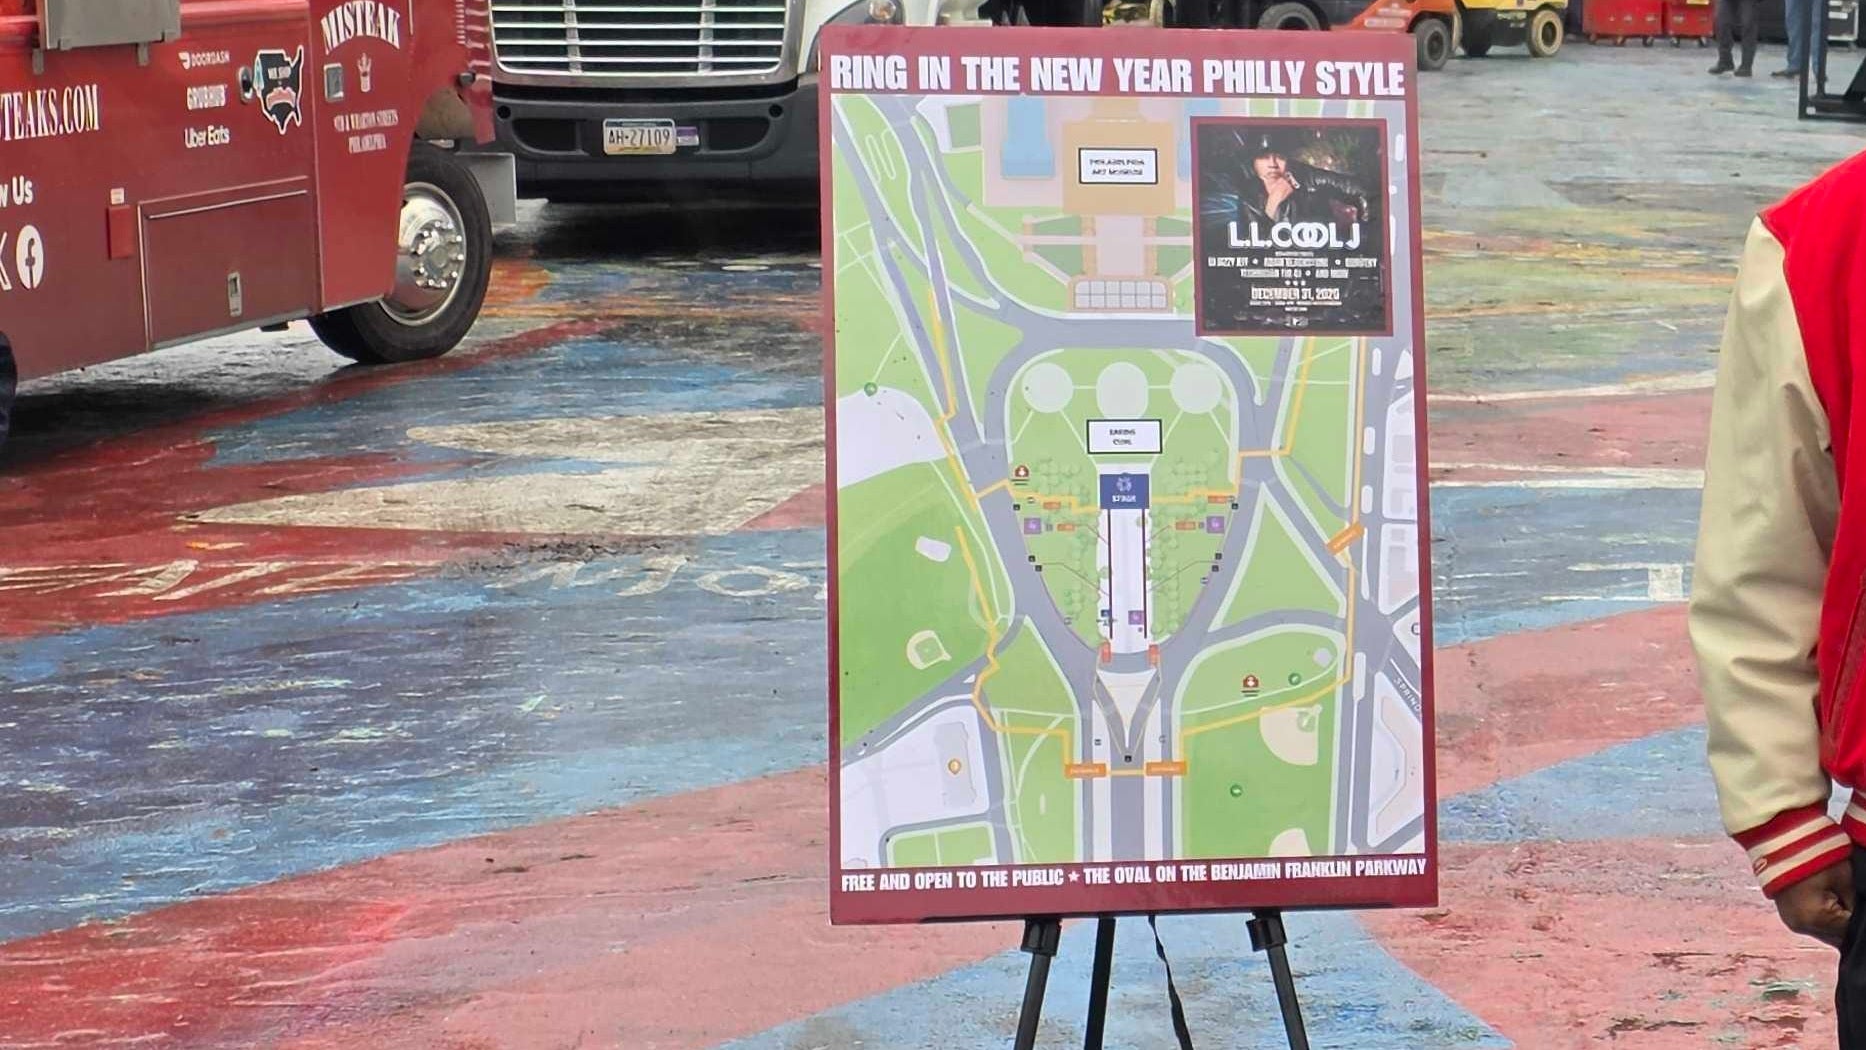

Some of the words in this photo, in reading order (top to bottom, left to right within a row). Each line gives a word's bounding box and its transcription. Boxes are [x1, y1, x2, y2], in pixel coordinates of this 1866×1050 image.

[320, 0, 400, 55] MISTEAK
[830, 55, 908, 90] RING
[918, 55, 950, 90] IN
[961, 56, 1020, 91] THE
[1030, 56, 1104, 92] NEW
[1112, 57, 1192, 93] YEAR
[1203, 59, 1305, 94] PHILLY
[1315, 60, 1405, 96] STYLE
[0, 84, 99, 141] TEAKS.COM
[185, 127, 206, 148] Uber
[207, 125, 230, 145] Eats
[12, 175, 33, 205] Us
[841, 872, 875, 892] FREE
[879, 872, 911, 891] AND
[914, 871, 953, 890] OPEN
[956, 871, 977, 889] TO
[980, 870, 1008, 888] THE
[1012, 868, 1064, 887] PUBLIC
[1083, 866, 1111, 885] THE
[1114, 865, 1151, 884] OVAL
[1156, 865, 1177, 882] ON
[1181, 864, 1207, 881] THE
[1211, 862, 1281, 881] BENJAMIN
[1285, 860, 1351, 879] FRANKLIN
[1355, 858, 1426, 877] PARKWAY
